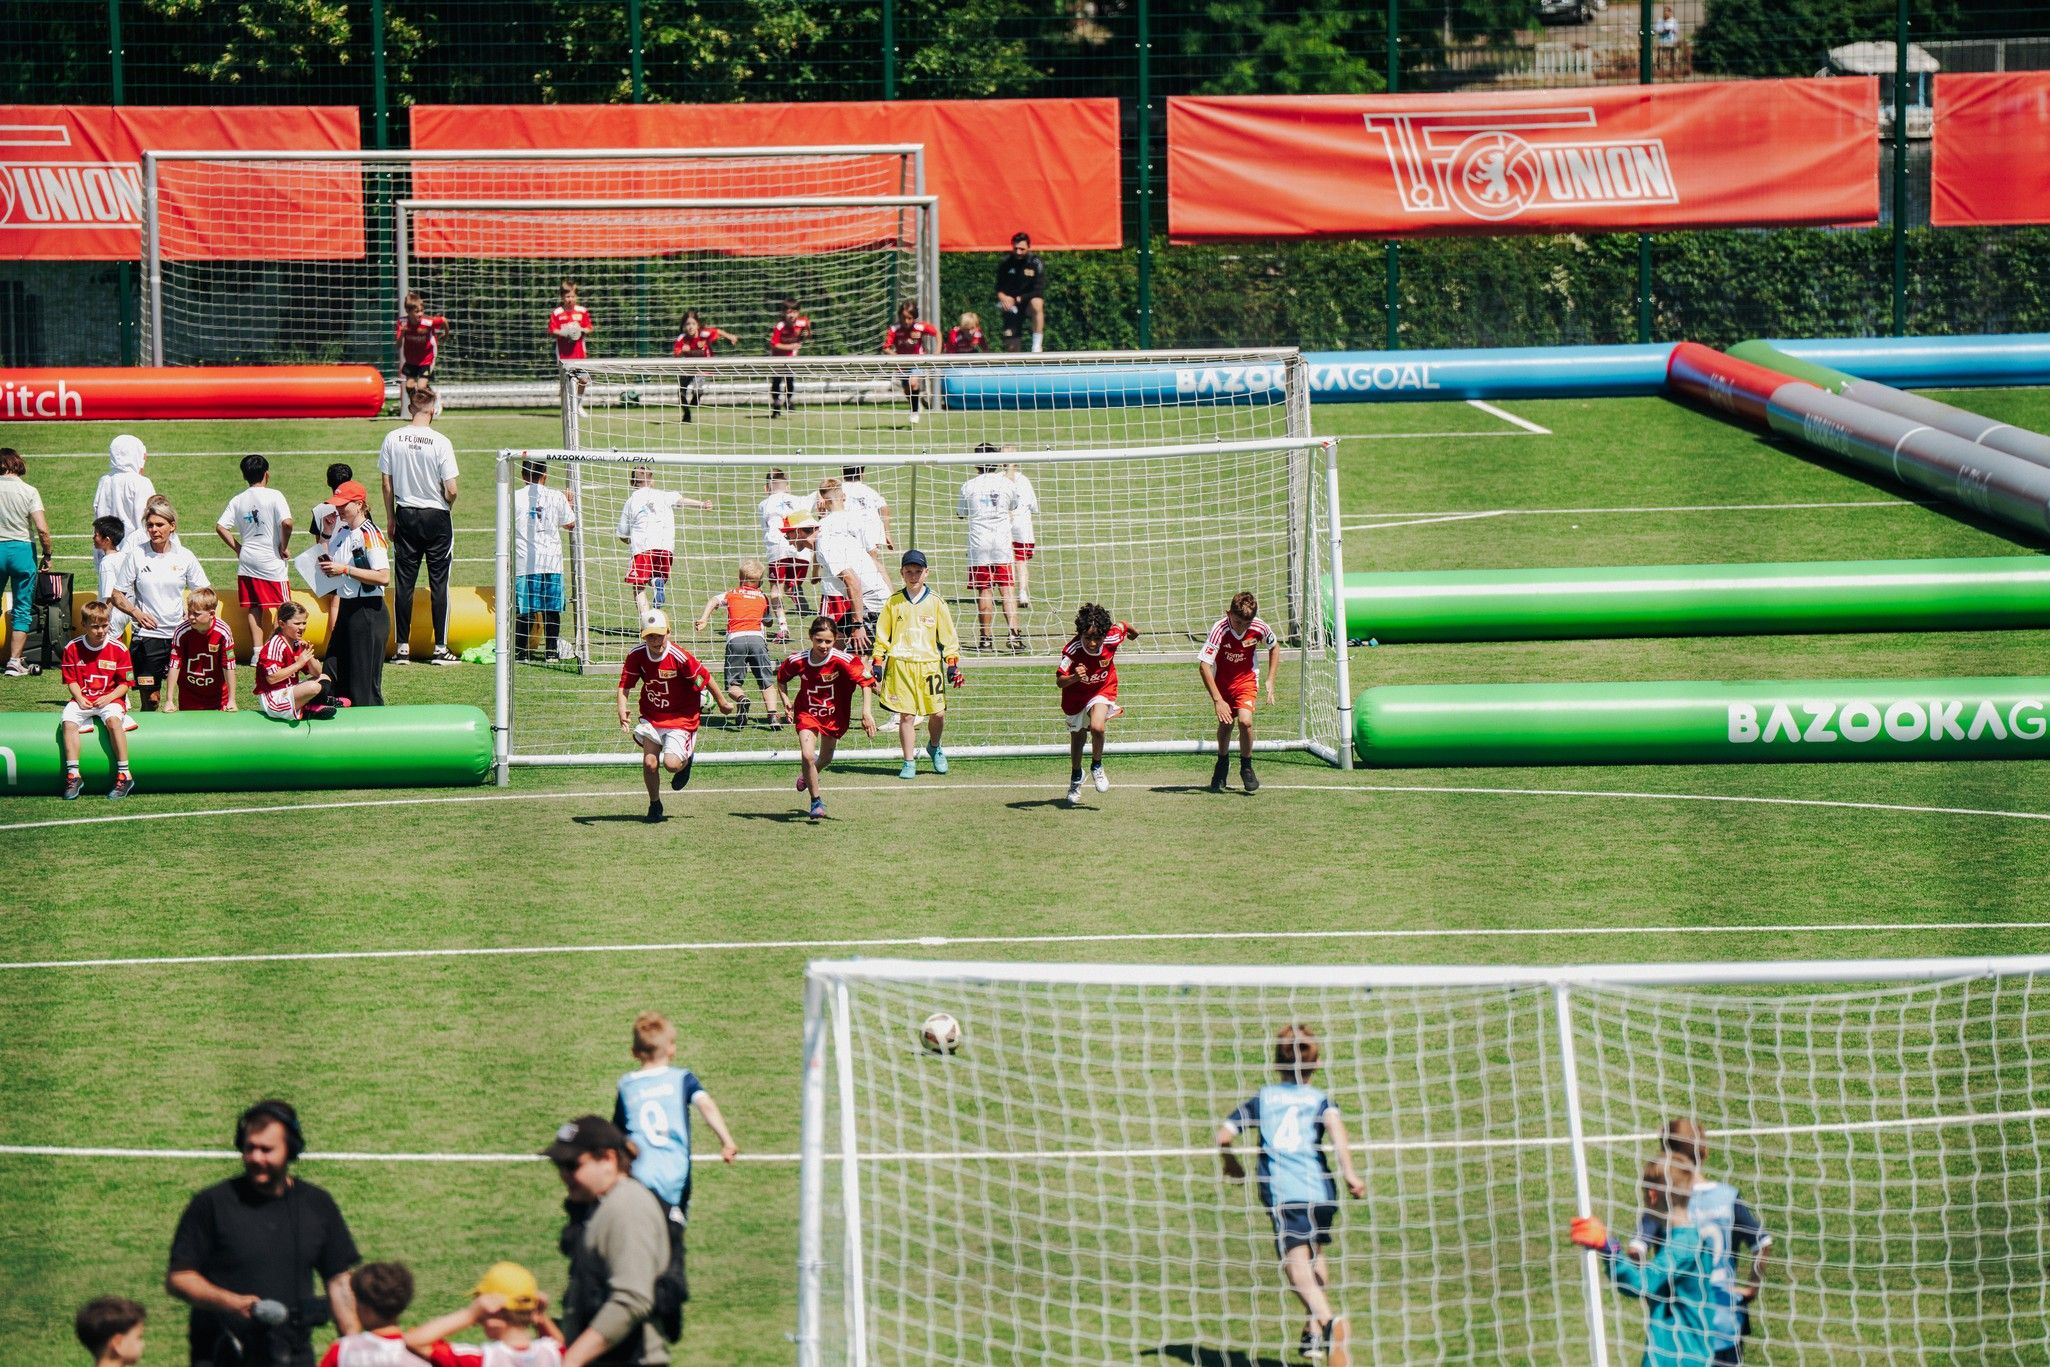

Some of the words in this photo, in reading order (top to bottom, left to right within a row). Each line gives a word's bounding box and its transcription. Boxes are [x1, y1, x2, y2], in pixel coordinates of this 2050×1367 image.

[1539, 146, 1671, 200] UNION
[12, 168, 142, 222] UNION
[0, 379, 82, 417] itch
[413, 436, 434, 446] UNION
[187, 676, 214, 686] GCP
[647, 692, 670, 708] GCP
[926, 674, 944, 695] 12
[1728, 699, 2048, 743] BAZOOKAG
[1273, 1106, 1303, 1153] 4
